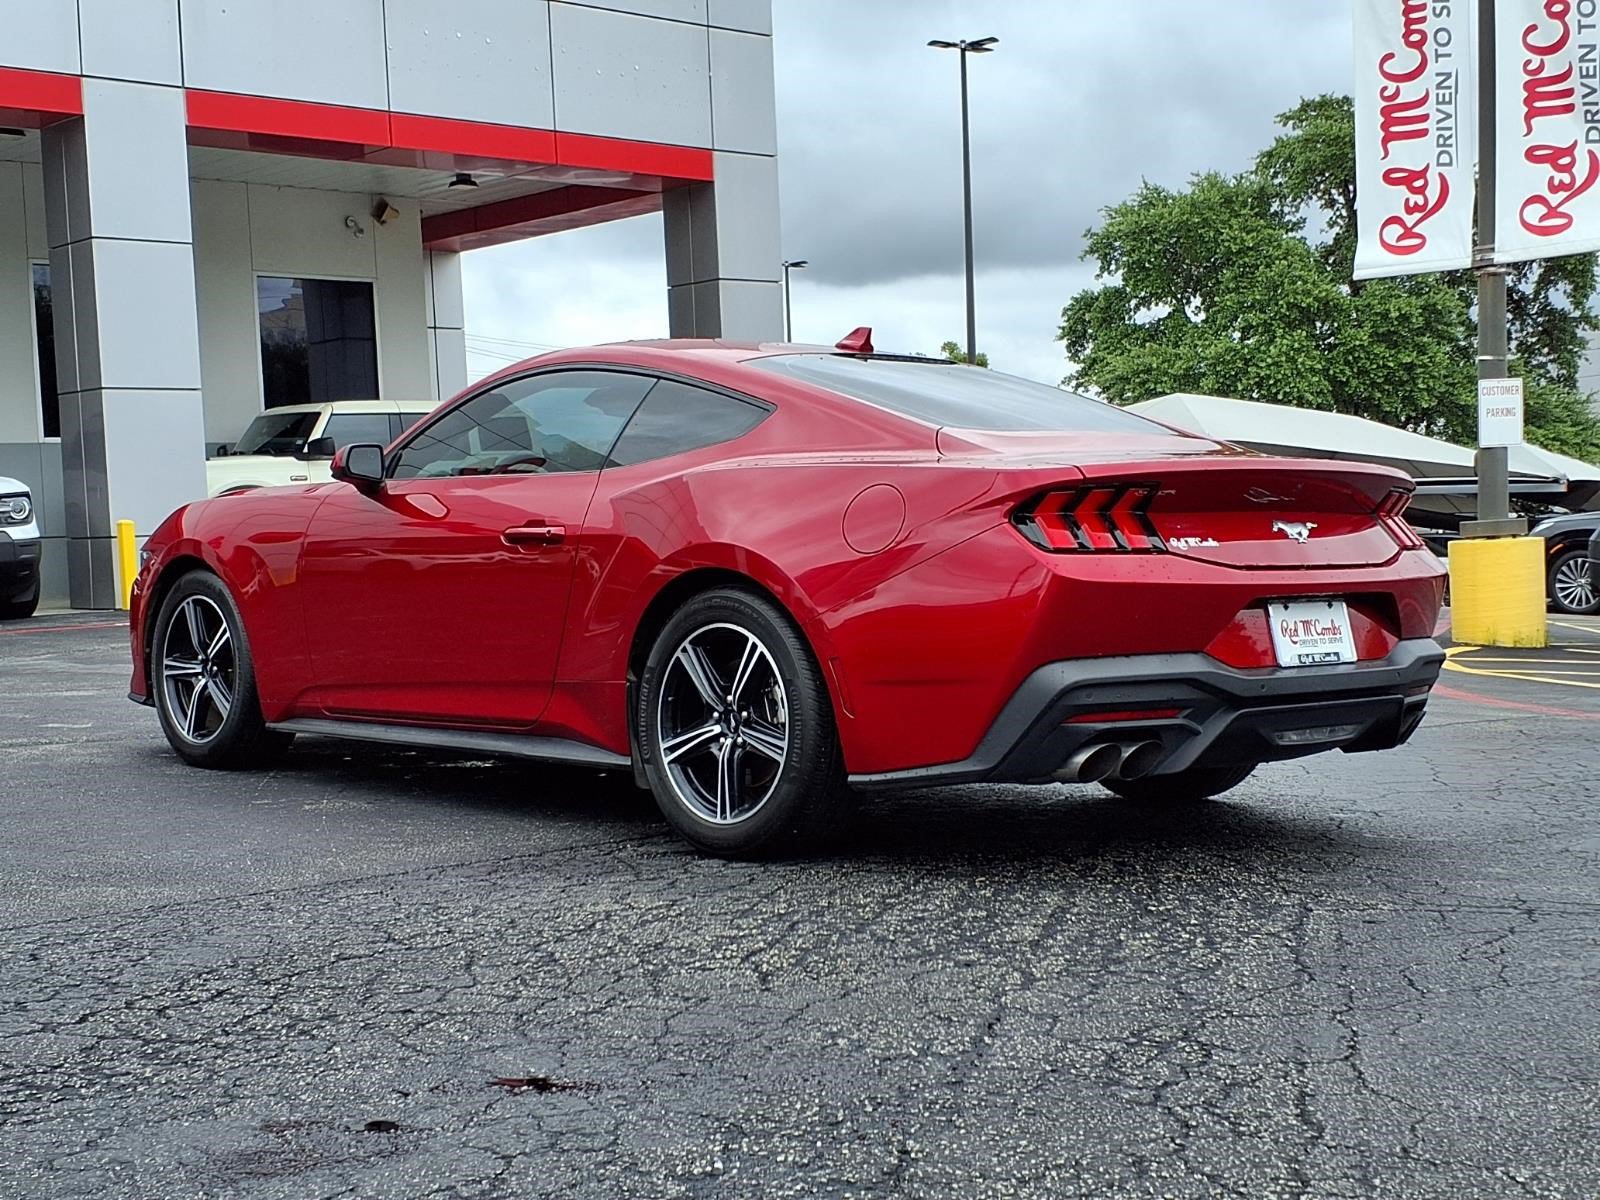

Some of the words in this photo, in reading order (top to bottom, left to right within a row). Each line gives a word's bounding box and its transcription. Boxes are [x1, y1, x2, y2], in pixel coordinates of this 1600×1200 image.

[1576, 0, 1597, 35] TO
[1433, 27, 1452, 64] TO
[1577, 43, 1600, 144] DRIVEN
[1434, 72, 1454, 168] DRIVEN
[1519, 139, 1600, 237] Red
[1379, 162, 1450, 256] Red
[1481, 385, 1520, 397] CUSTOMER
[1486, 407, 1516, 418] PARKING
[1281, 618, 1299, 645] Red
[1299, 618, 1343, 638] McCombs
[1299, 638, 1319, 646] DRIVEN
[1319, 637, 1327, 645] TO
[1327, 636, 1344, 645] SERVE
